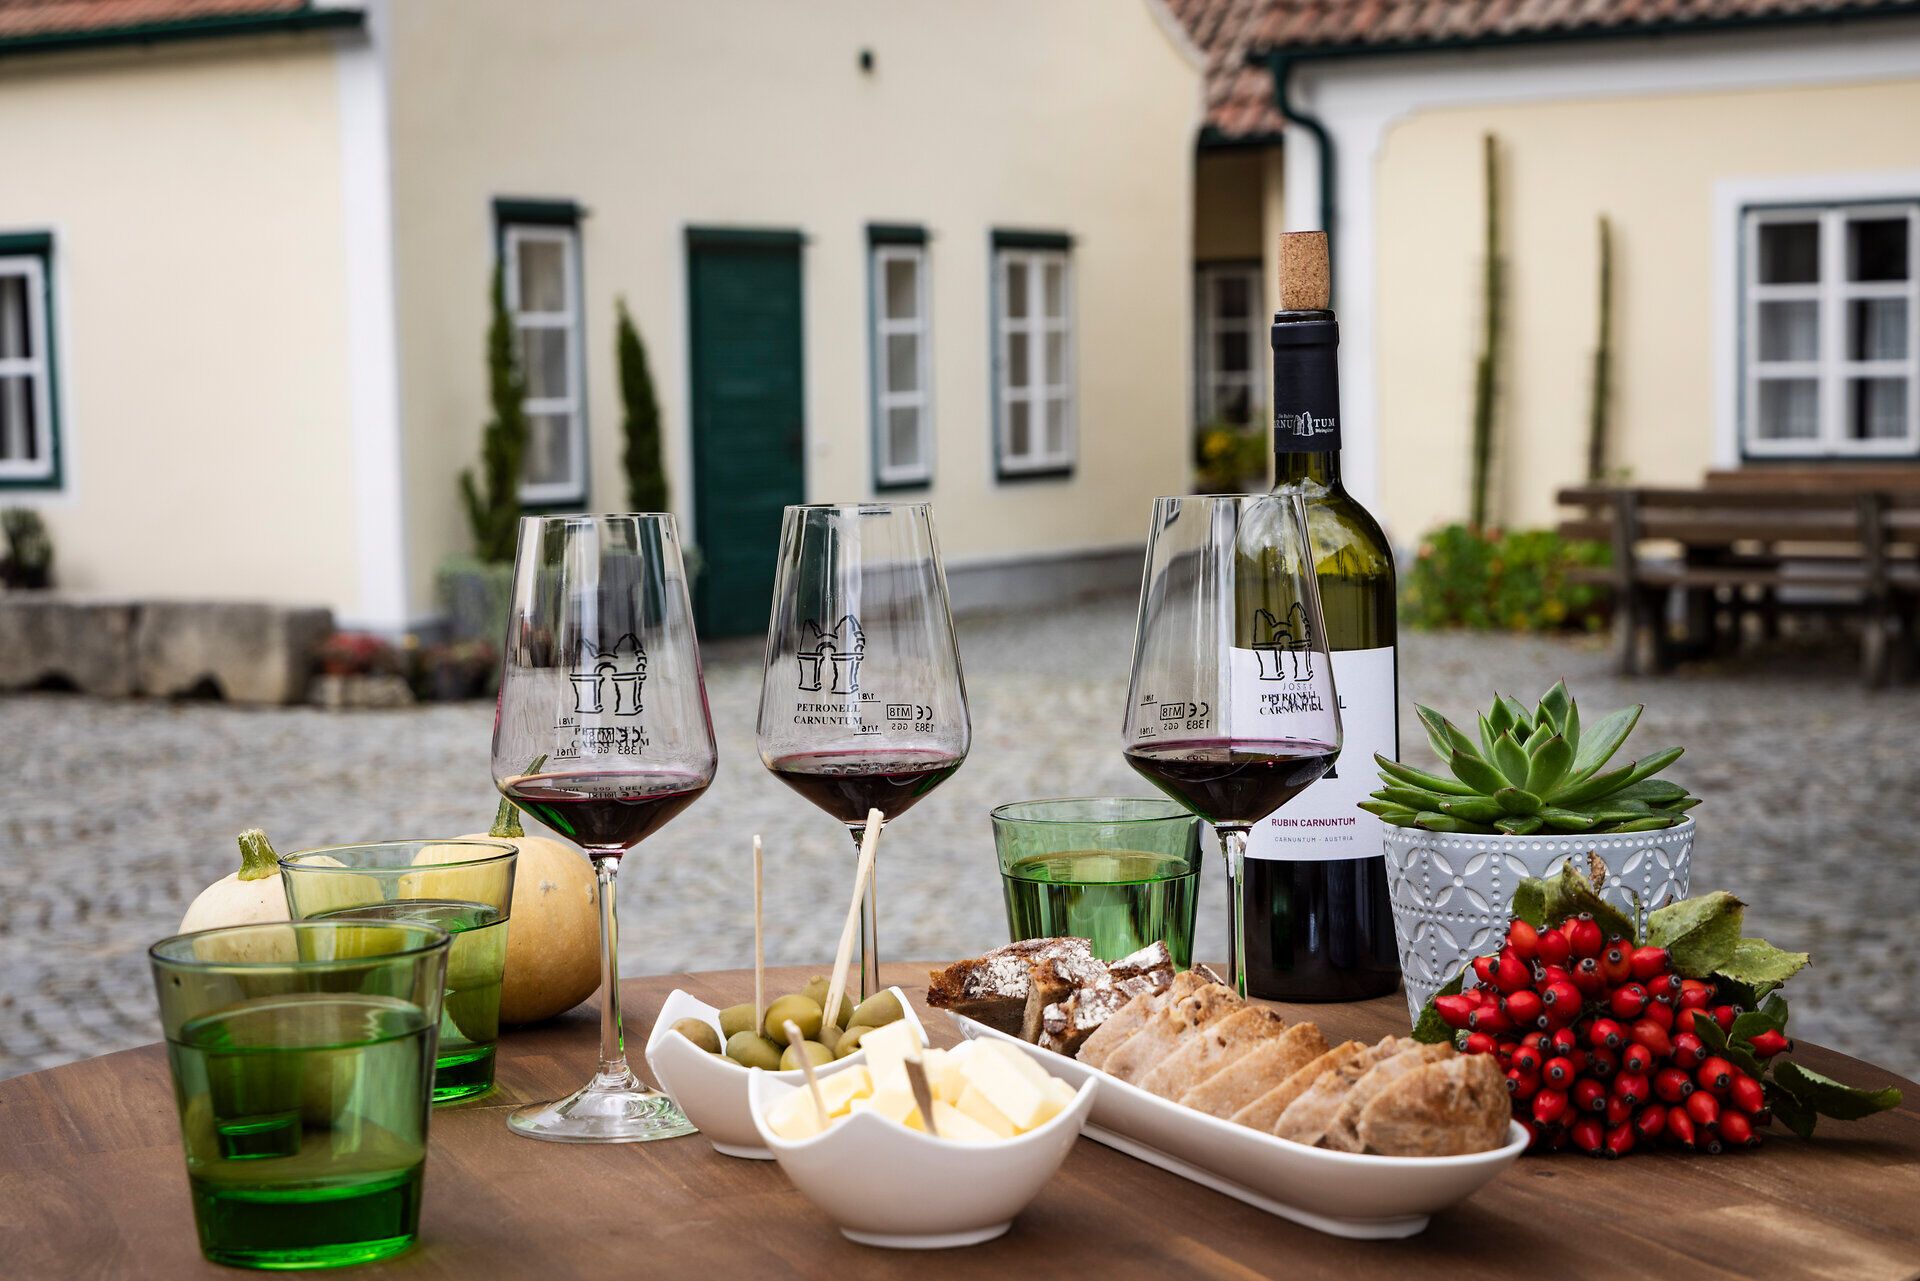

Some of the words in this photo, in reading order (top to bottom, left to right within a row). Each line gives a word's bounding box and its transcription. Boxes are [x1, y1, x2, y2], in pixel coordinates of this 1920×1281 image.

[1313, 418, 1335, 428] TUM
[797, 703, 861, 713] PETRONELL
[794, 715, 862, 725] CARNUNTUM
[1271, 818, 1298, 827] RUBIN
[1300, 817, 1356, 827] CARNUNTUM
